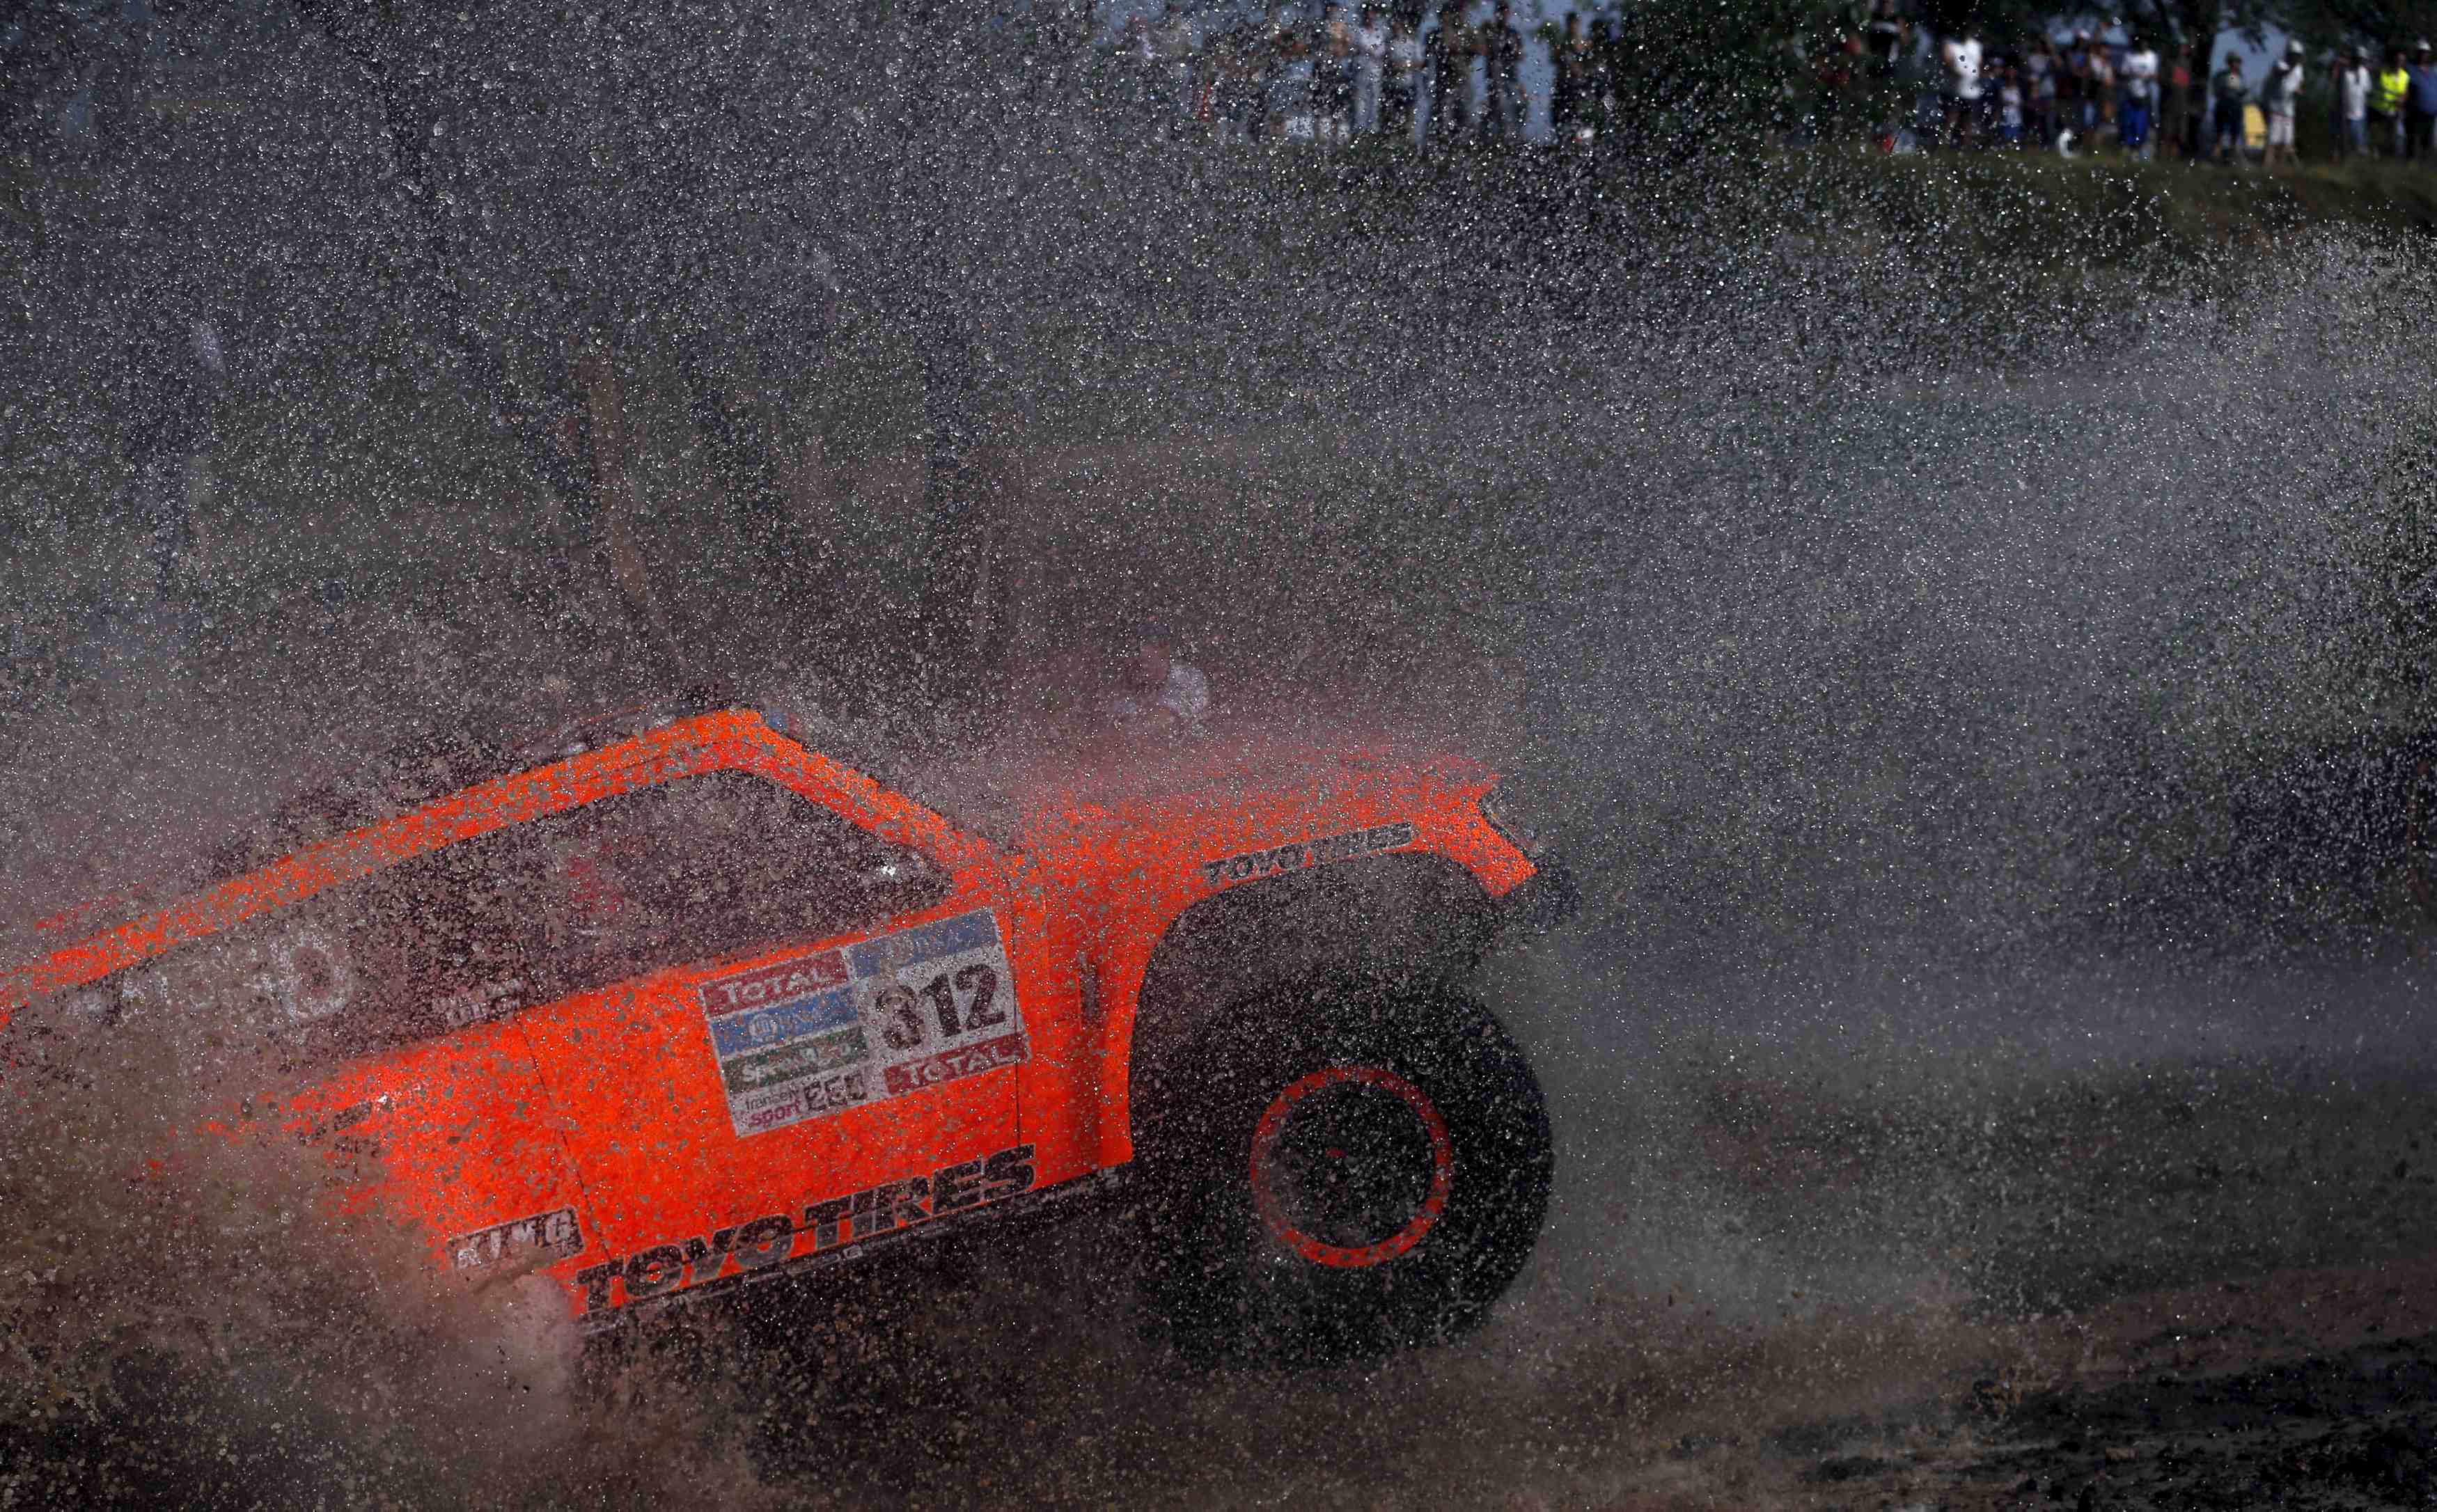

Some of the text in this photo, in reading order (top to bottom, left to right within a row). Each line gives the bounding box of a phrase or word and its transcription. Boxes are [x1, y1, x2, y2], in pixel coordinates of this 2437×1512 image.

[721, 969, 832, 1005] TOTAL
[876, 964, 1007, 1050] 312
[906, 1046, 1014, 1085] TOTAL
[576, 1144, 1036, 1314] TOYO TIRES
